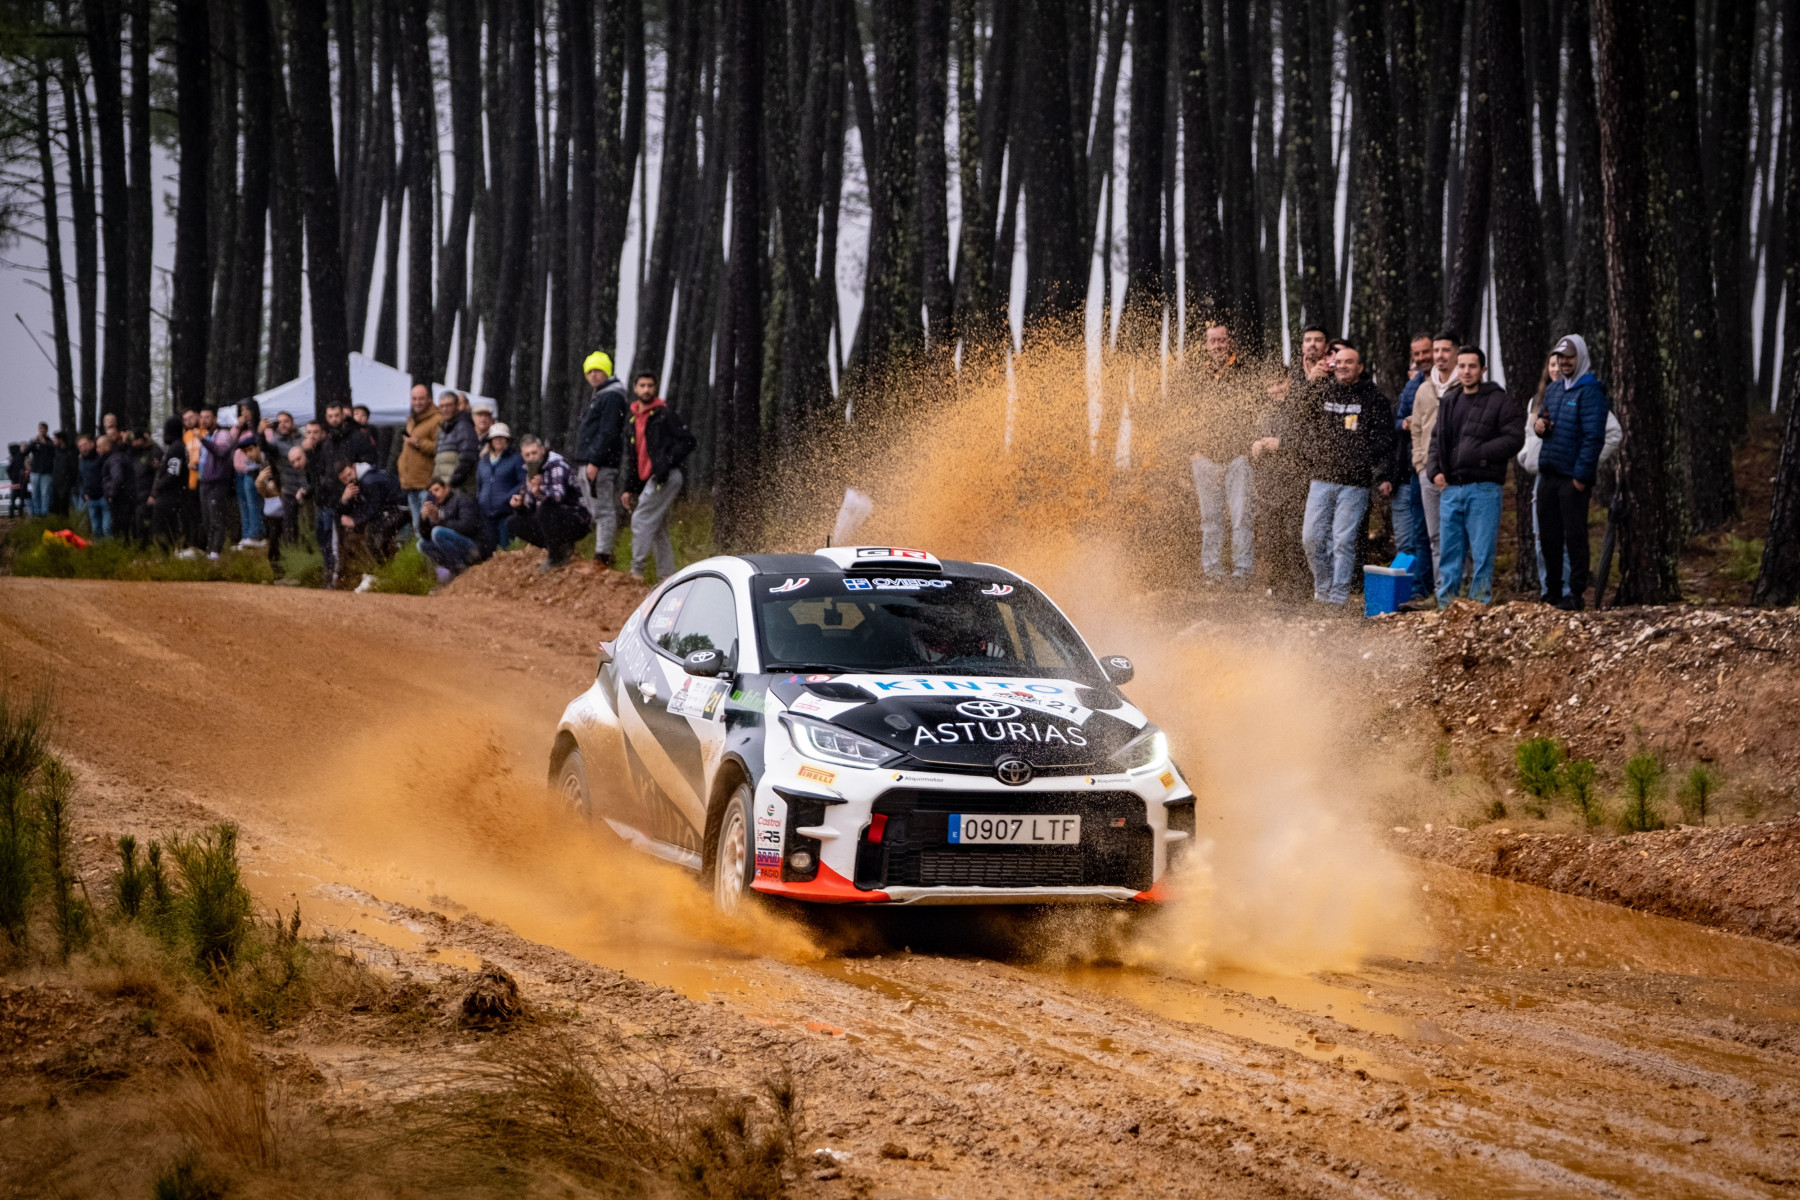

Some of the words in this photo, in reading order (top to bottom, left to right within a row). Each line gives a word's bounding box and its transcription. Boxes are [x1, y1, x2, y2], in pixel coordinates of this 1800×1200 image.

[857, 547, 927, 559] GR
[704, 691, 722, 713] 21
[1046, 700, 1079, 714] 21
[913, 722, 1088, 746] ASTURIAS
[798, 765, 836, 784] PIRELLI
[757, 816, 781, 827] Castrol
[964, 819, 1023, 840] 0907
[1032, 819, 1076, 840] LTF
[757, 850, 780, 864] BRAID
[760, 868, 780, 878] PAGID
